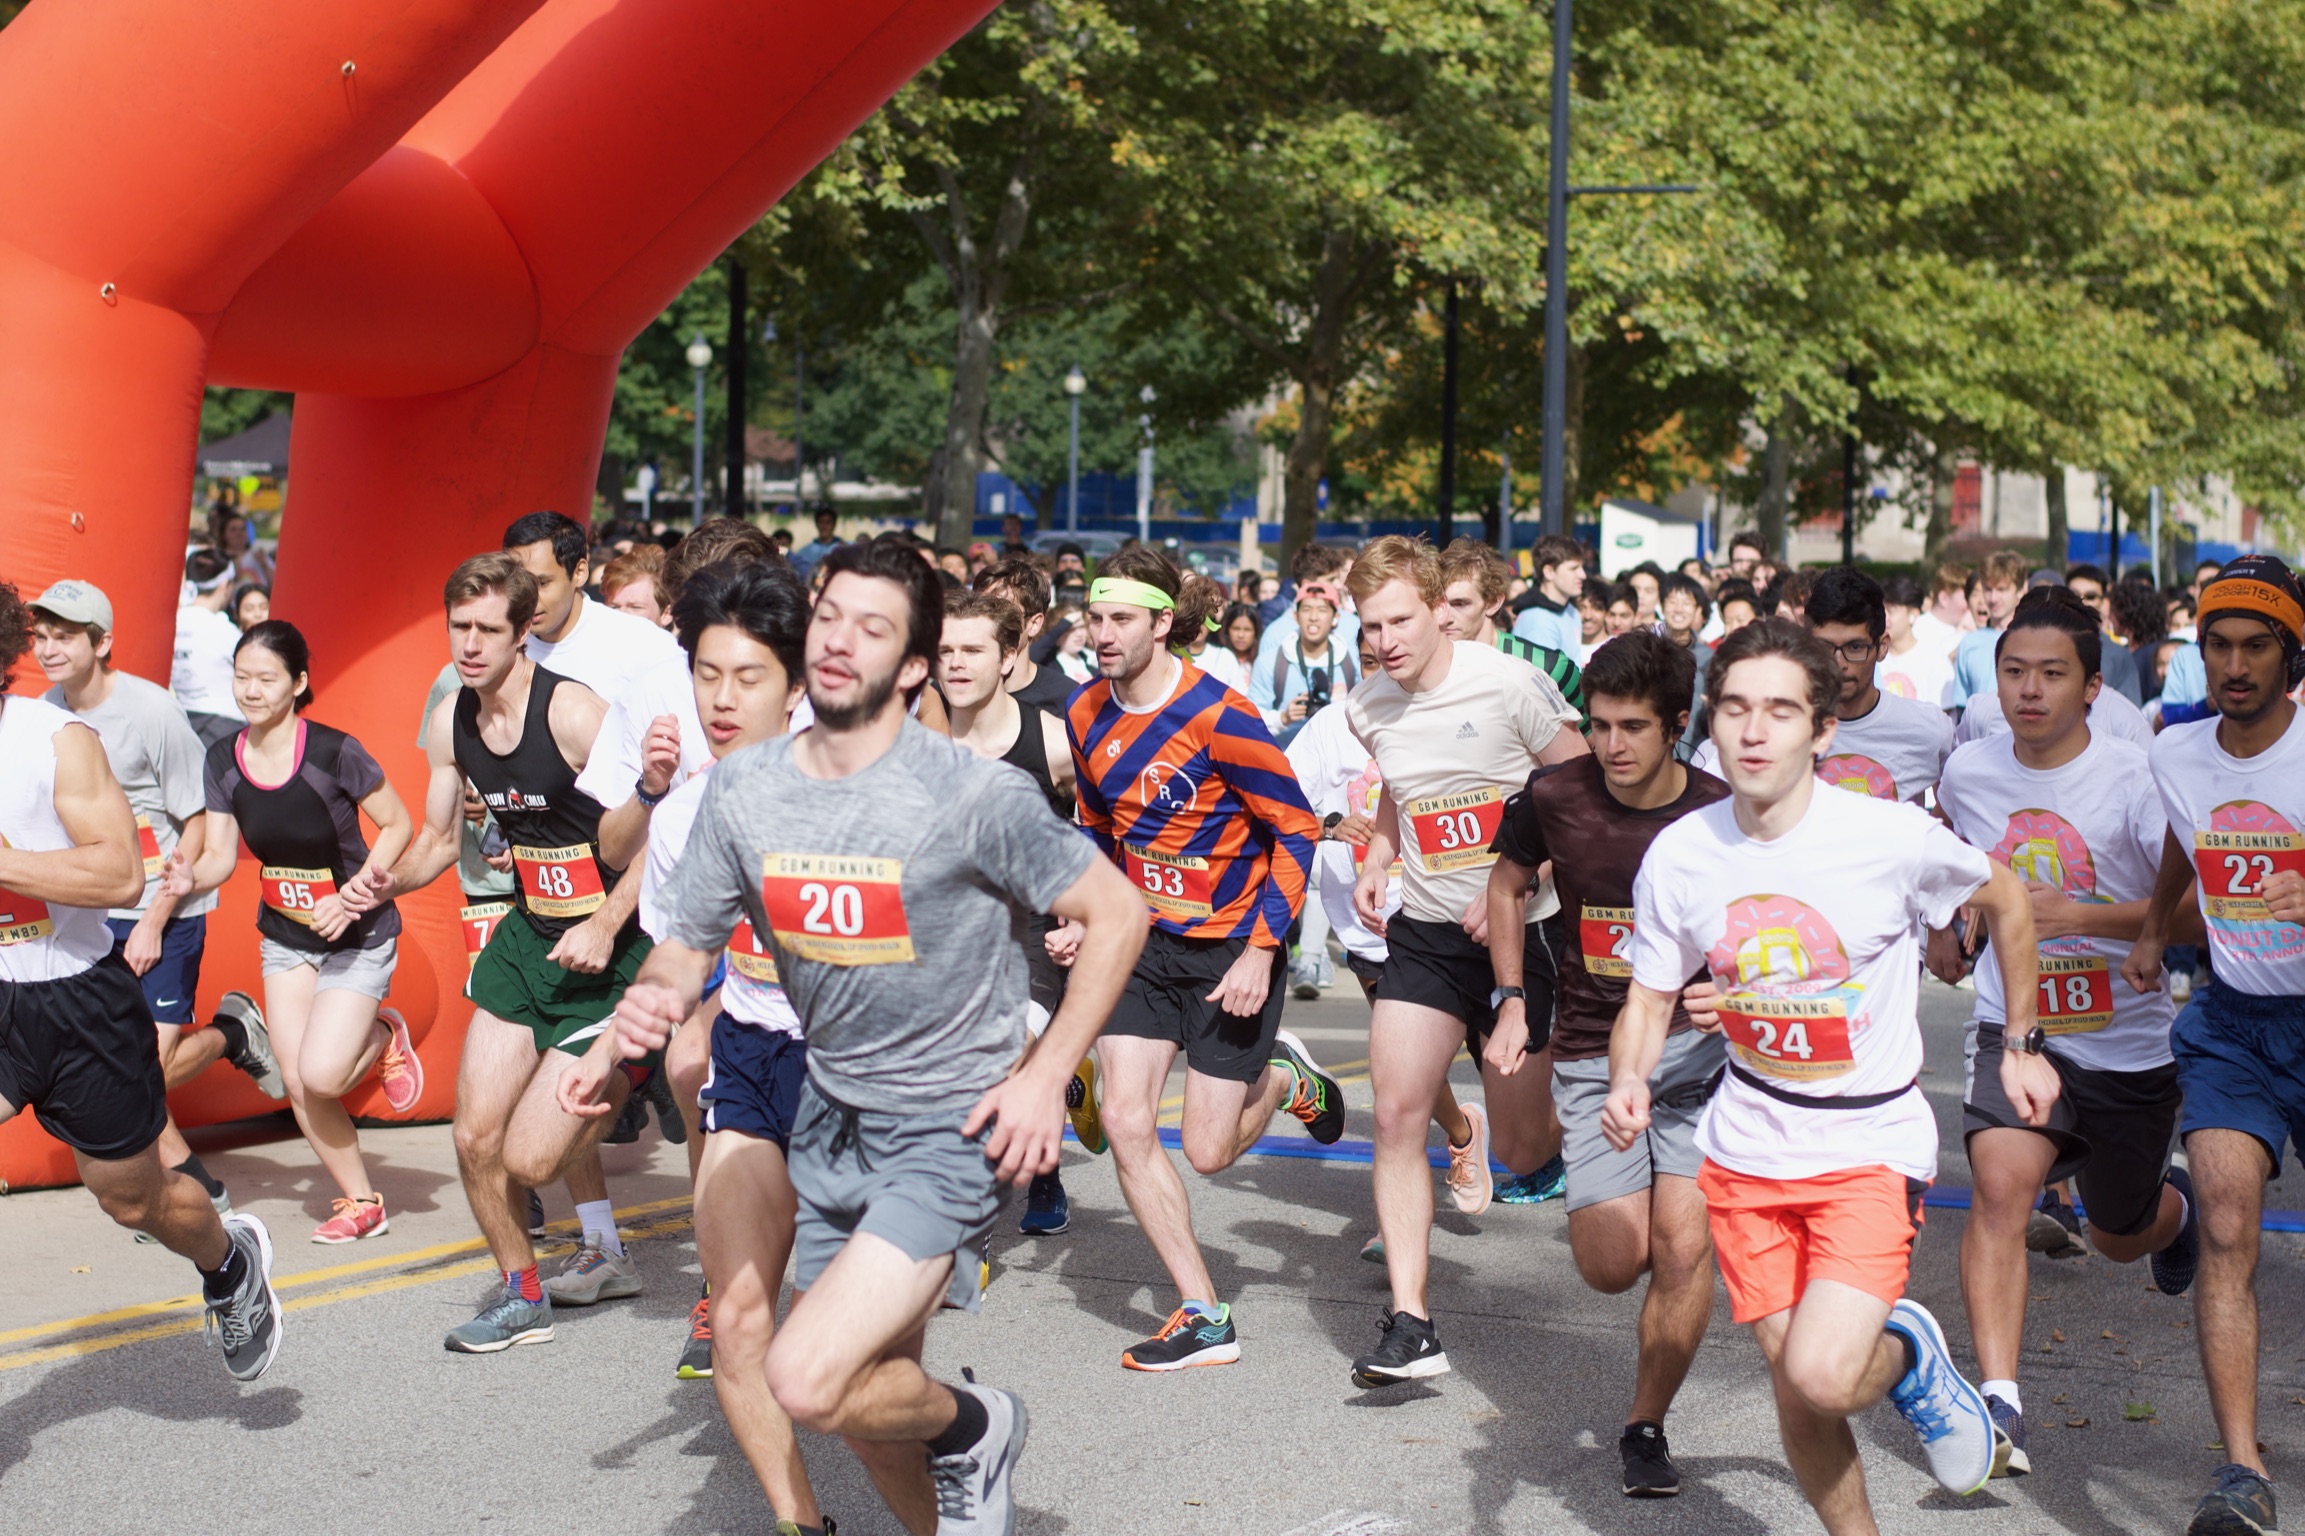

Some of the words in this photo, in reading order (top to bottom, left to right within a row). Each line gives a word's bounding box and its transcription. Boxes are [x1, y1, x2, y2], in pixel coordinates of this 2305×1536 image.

[2215, 584, 2250, 593] TOUGH
[2252, 586, 2281, 607] 15K
[1456, 731, 1479, 739] adidas
[524, 794, 547, 807] CMU
[1418, 799, 1439, 812] GBM
[1443, 791, 1489, 808] RUNNING
[1436, 811, 1482, 849] 30
[2205, 834, 2230, 846] GBM
[2235, 835, 2290, 848] RUNNING
[520, 848, 535, 858] GBM
[538, 848, 579, 860] RUNNING
[1129, 843, 1147, 857] GBM
[1151, 851, 1196, 867] RUNNING
[264, 868, 281, 877] GBM
[284, 870, 321, 880] RUNNING
[780, 858, 811, 872] GBM
[818, 860, 885, 876] RUNNING
[538, 865, 574, 898] 48
[1142, 862, 1185, 897] 53
[278, 881, 314, 910] 95
[472, 904, 512, 917] RUNNING
[799, 882, 864, 936] 20
[1588, 909, 1614, 919] GBM
[10, 925, 39, 940] GBM
[2041, 942, 2095, 953] ANNUAL
[2039, 960, 2093, 971] RUNNING
[1750, 983, 1781, 995] EST.
[1785, 983, 1822, 994] 2009
[2037, 976, 2093, 1014] 18
[1725, 999, 1754, 1012] GBM
[1762, 1002, 1829, 1014] RUNNING
[1750, 1020, 1813, 1059] 24
